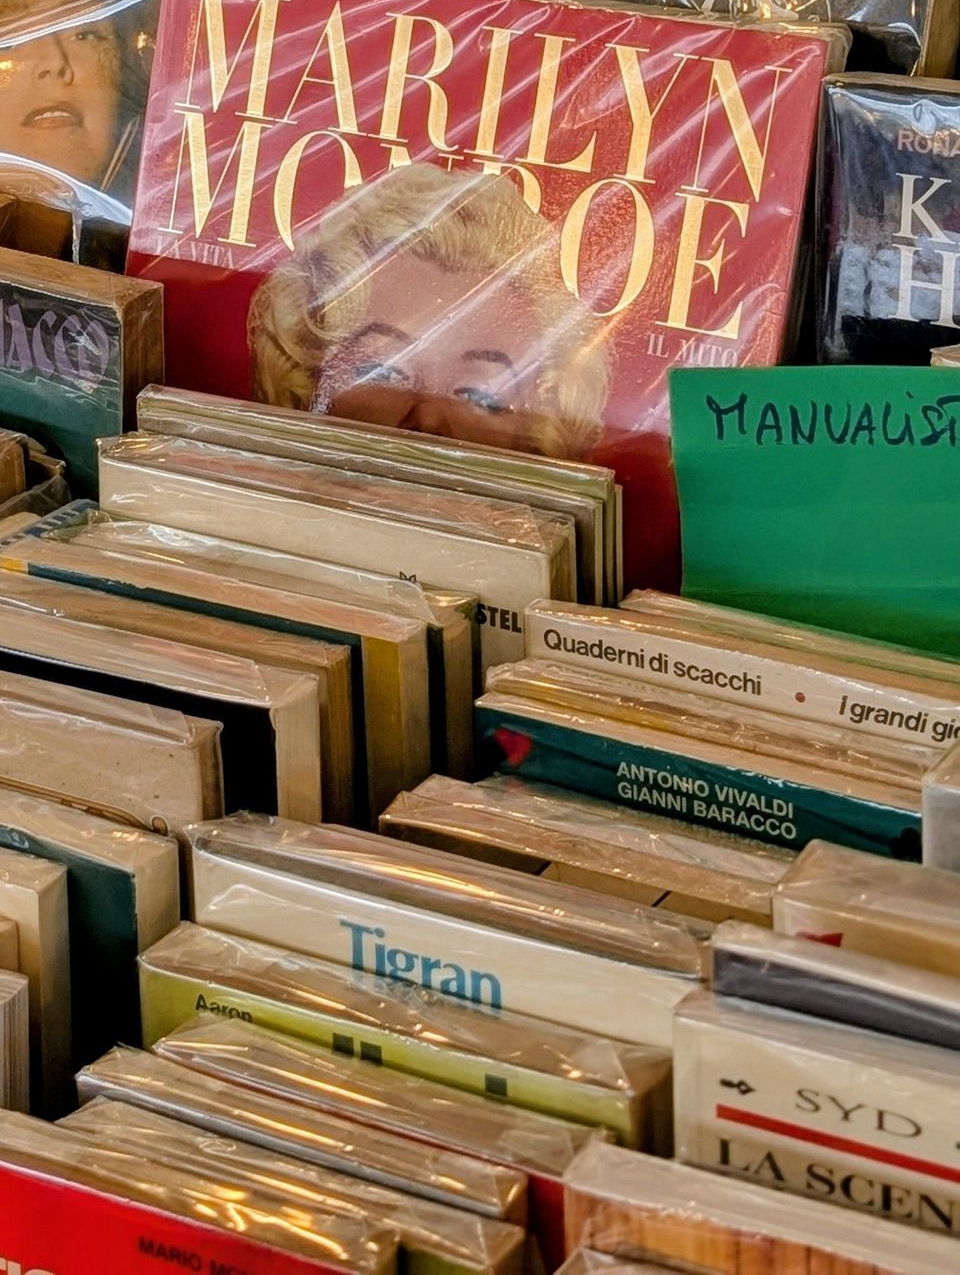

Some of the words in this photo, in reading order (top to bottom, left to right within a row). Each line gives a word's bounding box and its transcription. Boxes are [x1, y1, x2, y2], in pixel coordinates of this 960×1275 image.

[158, 110, 752, 339] MOOE
[156, 237, 182, 258] LA
[189, 242, 235, 269] VITA
[646, 333, 670, 358] IL
[677, 338, 740, 368] MITO
[543, 628, 645, 670] Quaderni
[649, 650, 669, 675] di
[673, 660, 762, 697] scacchi
[849, 701, 930, 734] grandi
[615, 760, 711, 799] ANTONIO
[714, 782, 794, 819] VIVALDI
[616, 780, 688, 814] GIANNI
[692, 799, 798, 841] BARACCO
[340, 919, 504, 1011] Tigran
[195, 992, 254, 1024] Aaron
[795, 1087, 923, 1138] SYD
[718, 1137, 786, 1183] LA
[138, 1235, 204, 1272] MARIO
